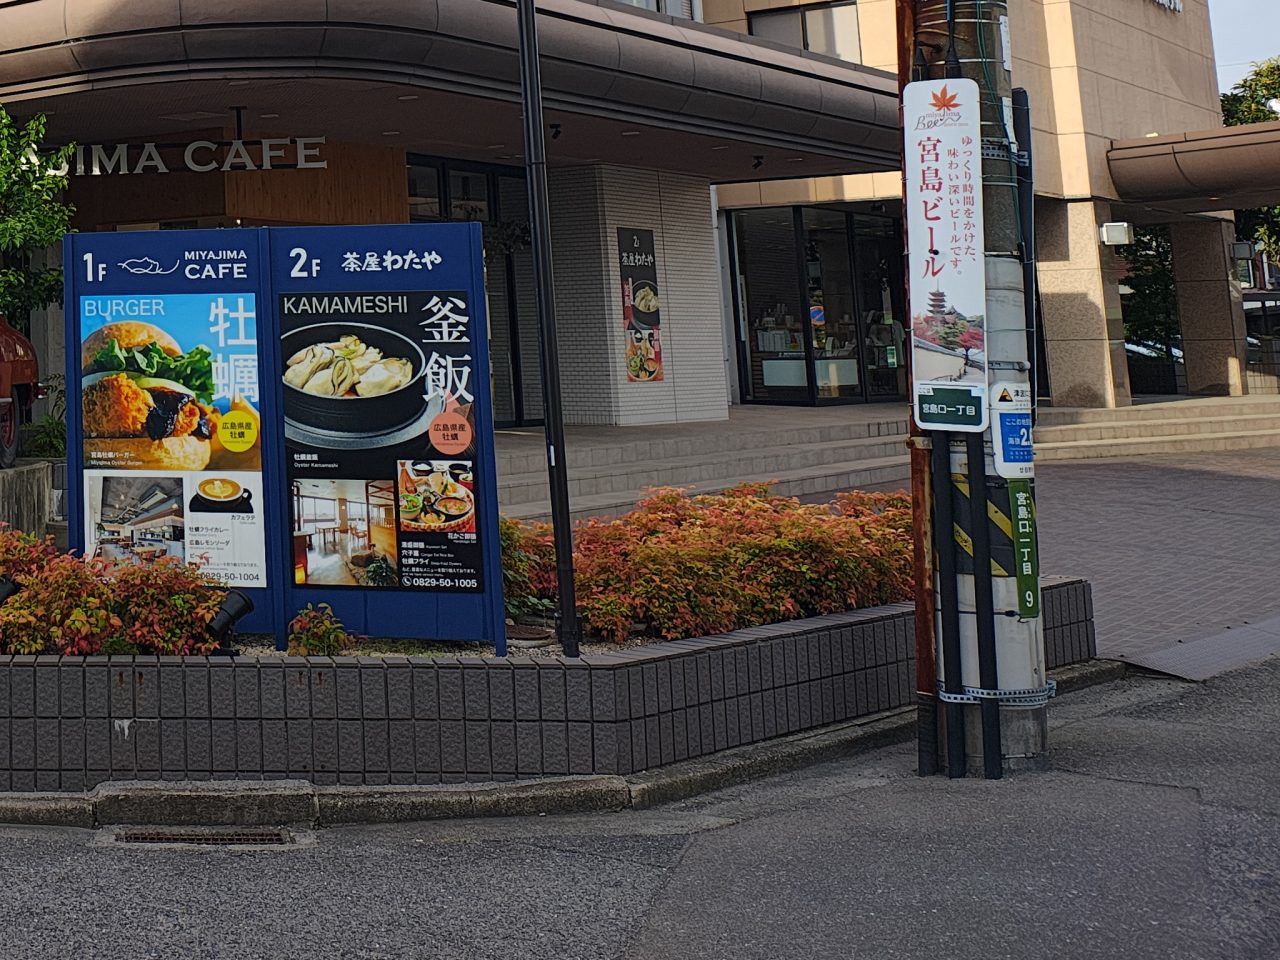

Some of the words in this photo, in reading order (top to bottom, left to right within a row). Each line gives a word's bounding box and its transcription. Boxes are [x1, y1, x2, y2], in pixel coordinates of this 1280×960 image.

[184, 136, 328, 171] CAFE
[917, 136, 946, 279] 宮島ビール
[947, 147, 962, 276] 味わい深いビールです。
[961, 135, 976, 262] ゆっくり時間をかけた、
[83, 252, 107, 282] 1F
[184, 250, 248, 260] MIYAJIMA
[289, 247, 320, 278] 2F
[341, 249, 443, 272] 茶屋わたや
[184, 263, 248, 279] CAFE
[84, 299, 166, 316] BURGER
[283, 295, 408, 314] KAMAMESHI
[209, 297, 260, 403] 牡蠣
[418, 295, 474, 403] 釜飯
[923, 404, 975, 415] 宮島口一丁目
[433, 423, 466, 432] 広島県産
[1016, 492, 1031, 575] 宮島口一丁目
[413, 578, 477, 588] 0829-50-1005
[1025, 591, 1034, 607] 9
